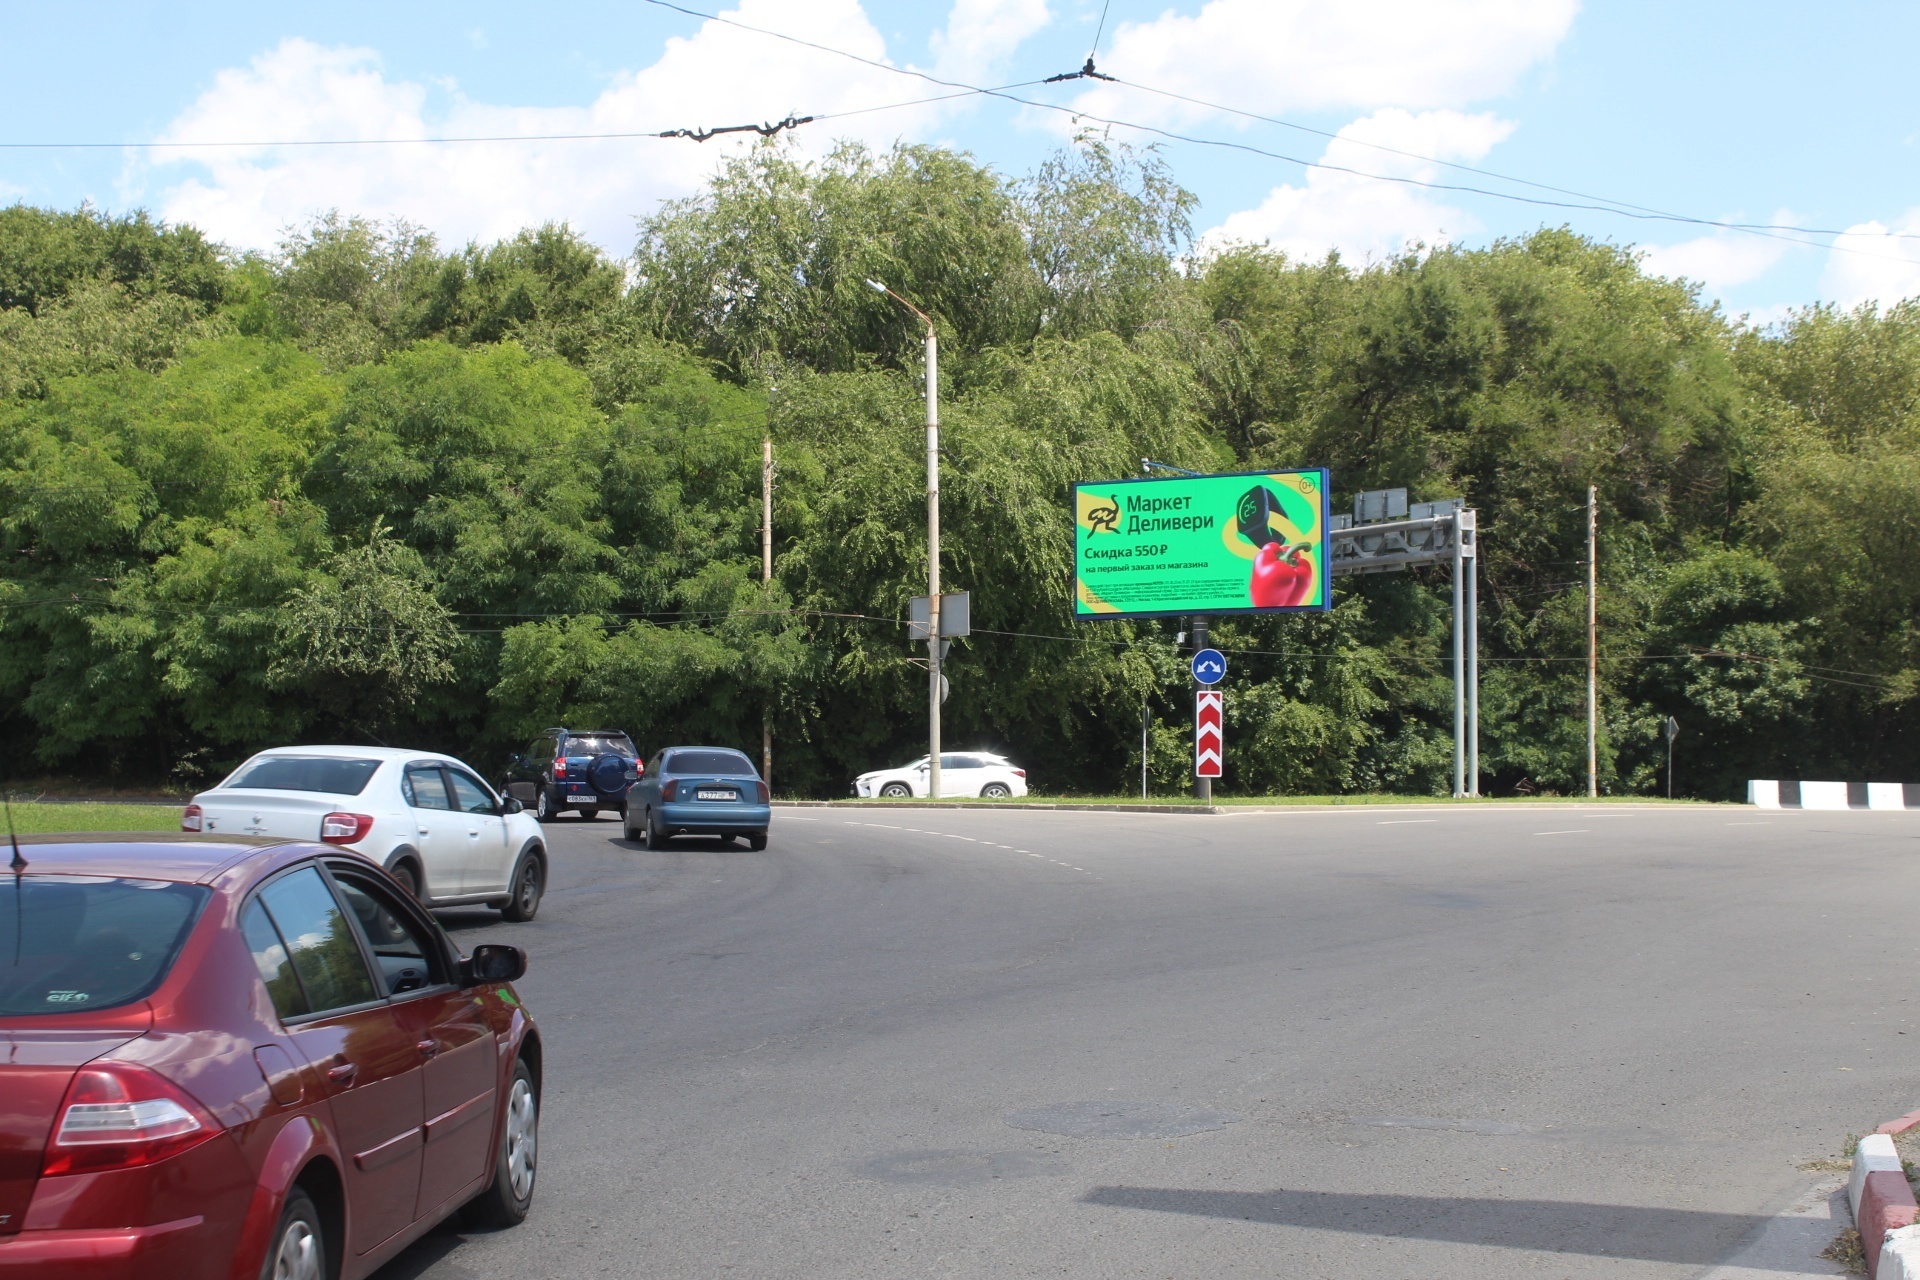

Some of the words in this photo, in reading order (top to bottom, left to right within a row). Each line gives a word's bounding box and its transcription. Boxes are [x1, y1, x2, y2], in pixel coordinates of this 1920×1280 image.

[1127, 495, 1192, 514] Маркет
[1244, 500, 1257, 517] 25
[1127, 515, 1214, 536] Деливери
[1084, 548, 1132, 560] Скидка
[1097, 565, 1129, 574] первый
[1131, 563, 1155, 571] заказ
[1167, 561, 1208, 570] магазина
